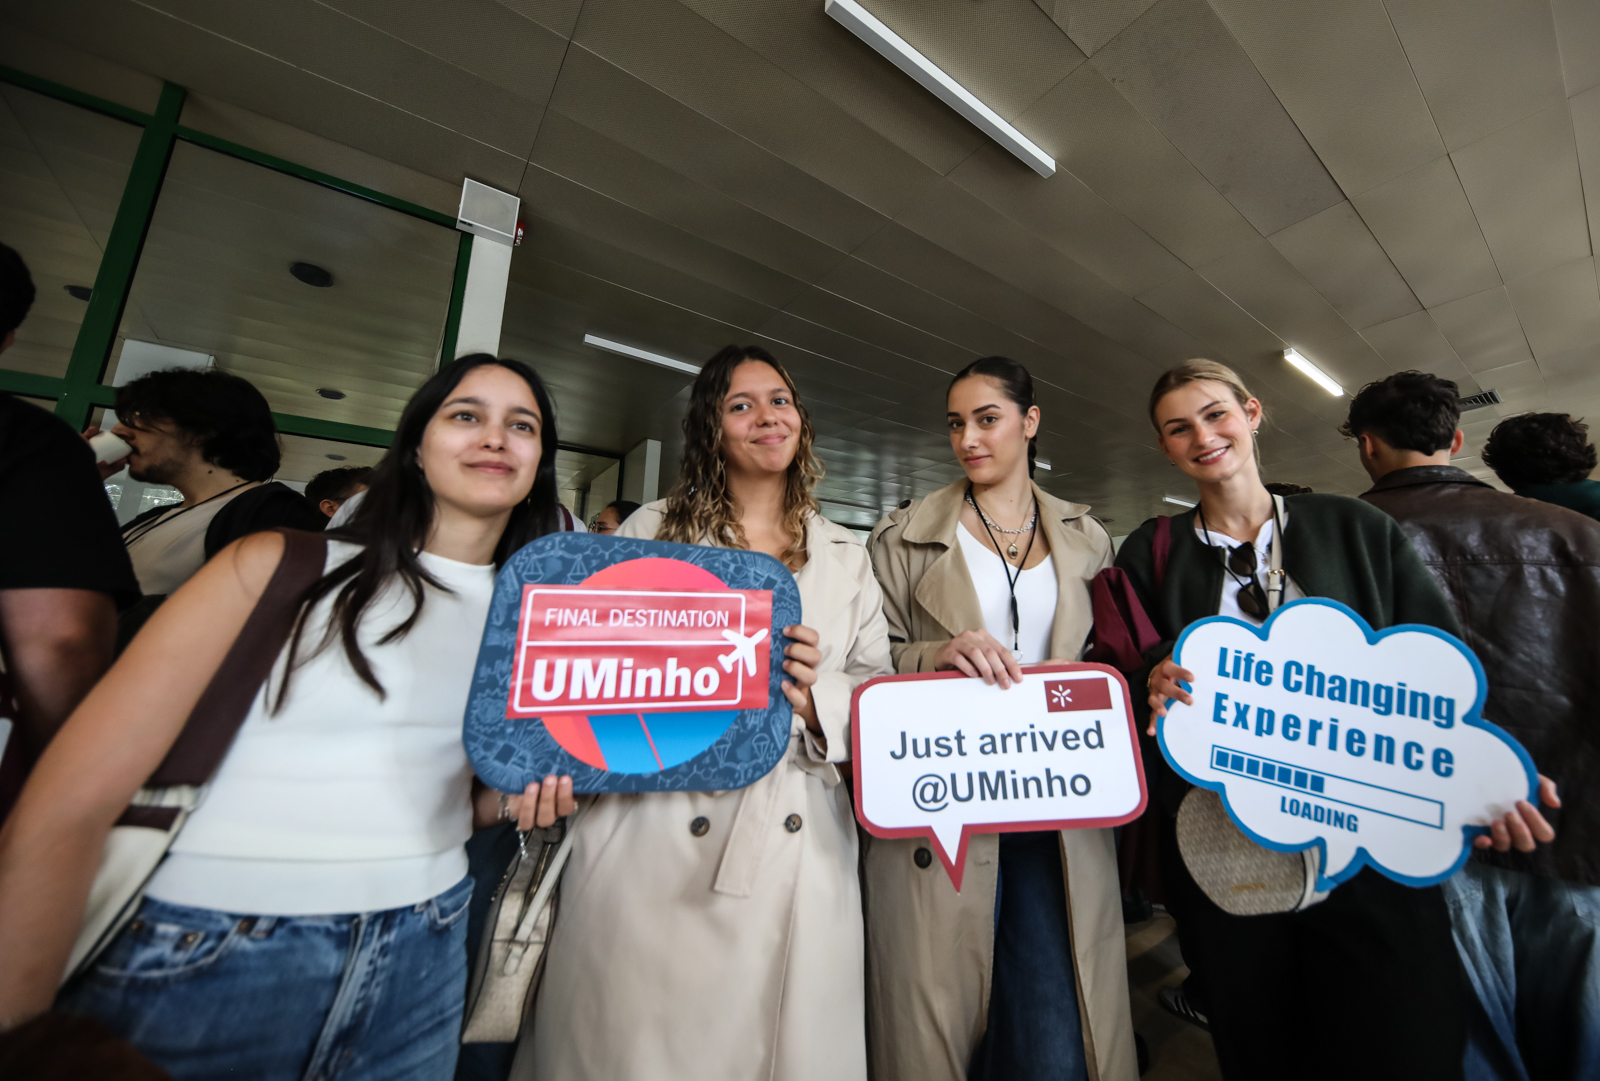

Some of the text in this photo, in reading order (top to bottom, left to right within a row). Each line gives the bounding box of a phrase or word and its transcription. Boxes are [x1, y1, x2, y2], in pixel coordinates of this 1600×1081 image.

[544, 608, 729, 627] FINAL DESTINATION
[531, 657, 720, 701] UMinho
[1217, 646, 1455, 729] Life Changing
[890, 720, 1105, 760] Just arrived
[1212, 692, 1454, 778] Experience
[912, 767, 1092, 812] @UMinho
[1280, 796, 1359, 833] LOADING
